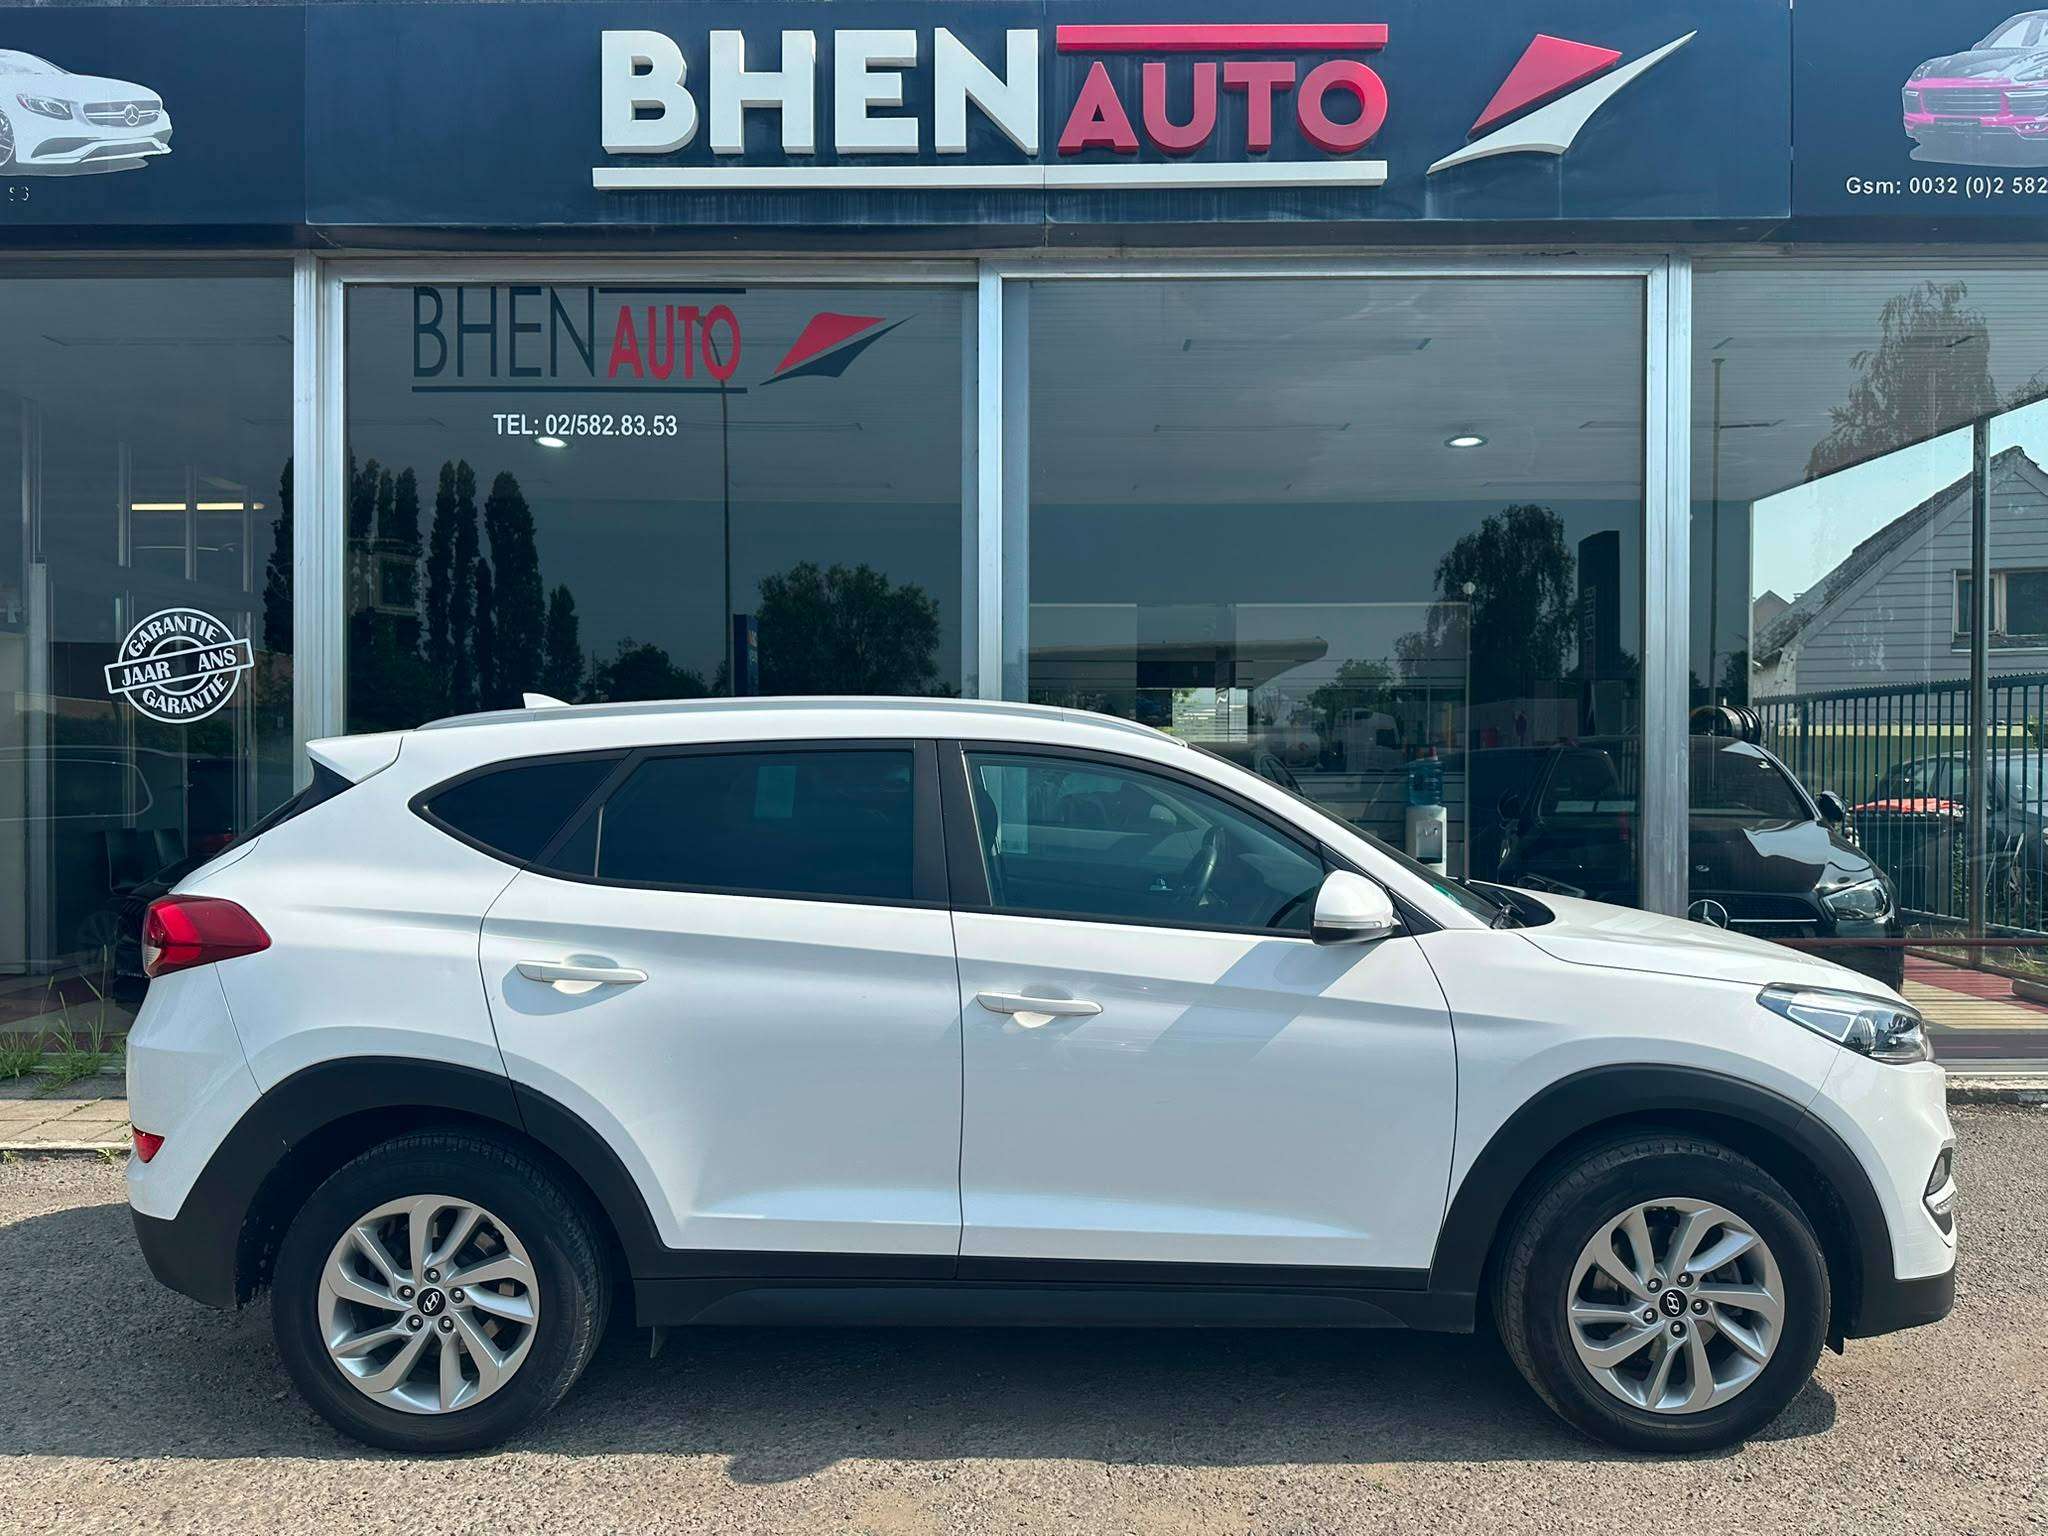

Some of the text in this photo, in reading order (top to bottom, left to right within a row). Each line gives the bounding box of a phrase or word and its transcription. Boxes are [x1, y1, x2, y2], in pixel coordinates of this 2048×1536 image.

[602, 28, 1388, 155] BHEN AUTO
[1846, 177, 2048, 198] Gsm: 0032 (0)2 582
[413, 286, 742, 381] BHEN AUTO
[493, 414, 677, 436] TEL: 02/582.83.53
[128, 615, 220, 657] GARANTIE
[122, 647, 237, 686] JAAR ANS
[142, 674, 229, 714] GARANTIE
